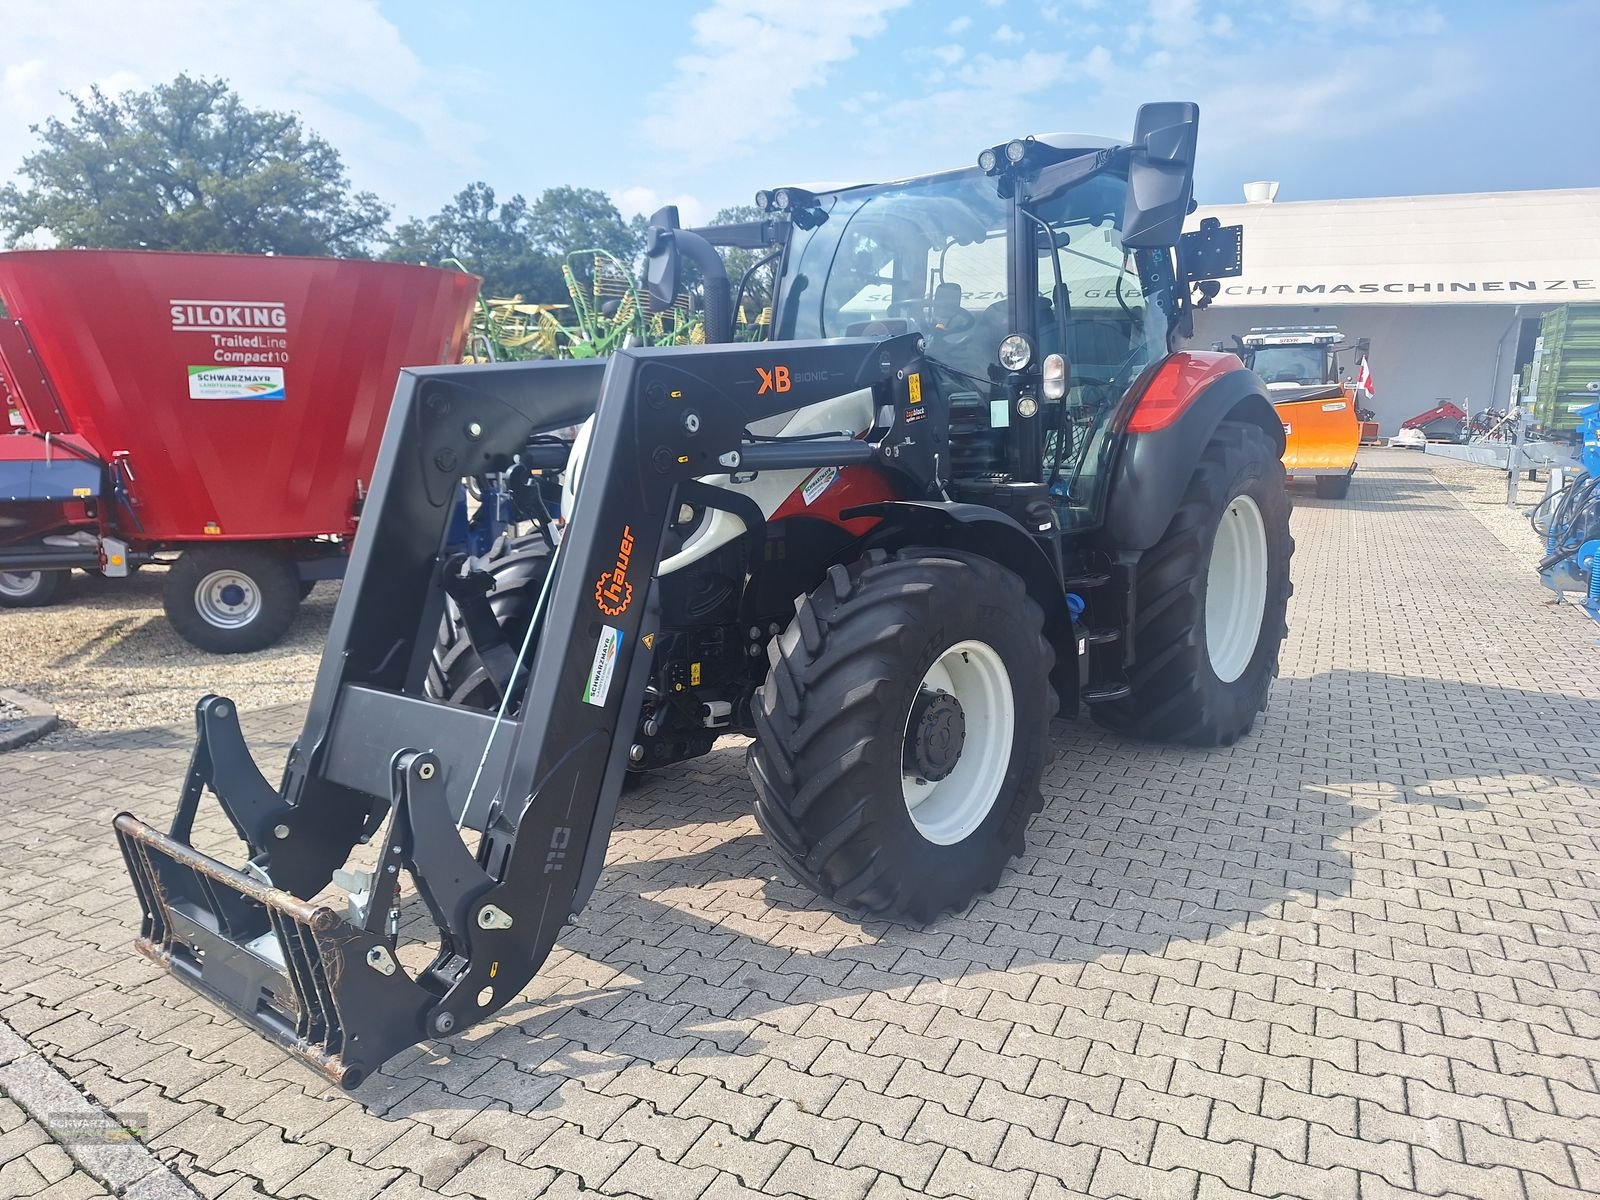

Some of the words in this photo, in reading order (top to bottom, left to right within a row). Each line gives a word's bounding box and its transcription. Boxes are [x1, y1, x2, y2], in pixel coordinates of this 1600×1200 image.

[171, 306, 286, 327] SILOKING
[211, 334, 287, 348] TrailedLine
[197, 374, 271, 382] SCHWARZMAYR
[795, 371, 828, 383] BIONIC
[603, 525, 635, 603] hauer
[590, 637, 611, 697] SCHWARZMAYR
[543, 826, 571, 874] 110
